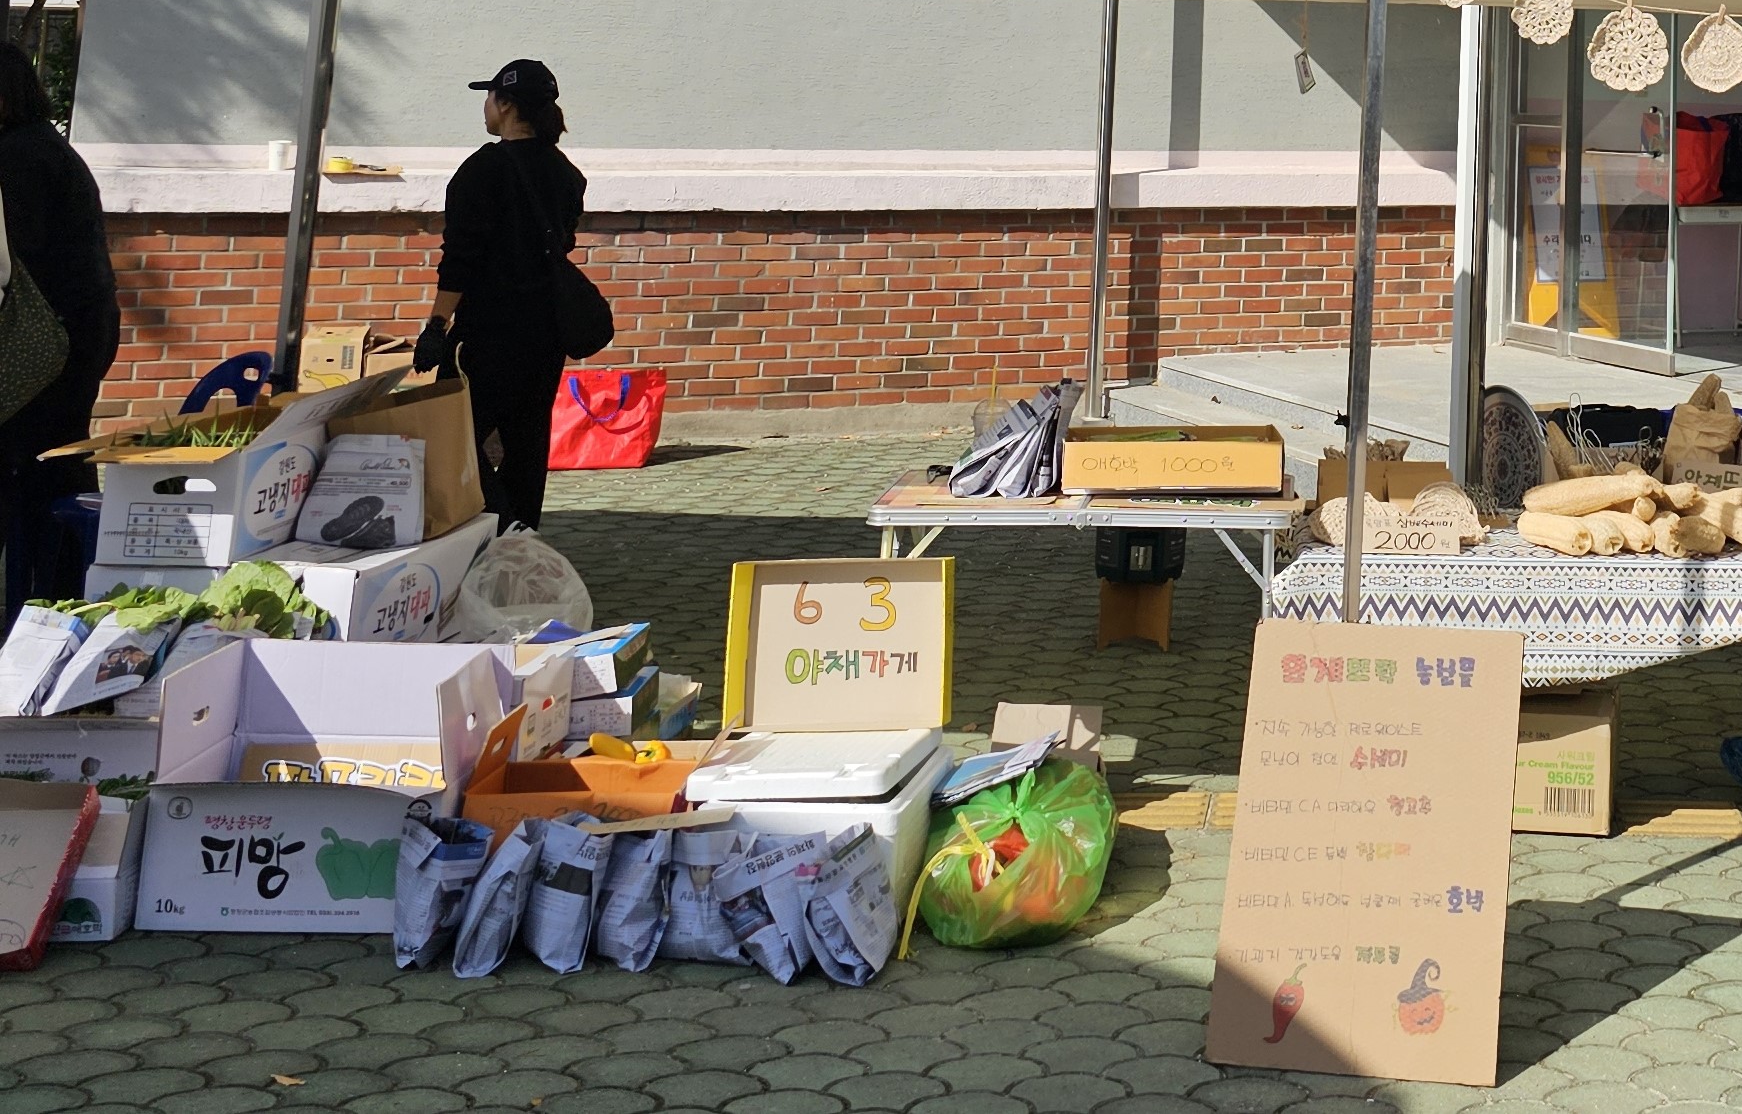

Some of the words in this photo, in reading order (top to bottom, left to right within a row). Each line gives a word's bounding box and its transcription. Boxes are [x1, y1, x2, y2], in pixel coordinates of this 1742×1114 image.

[1082, 454, 1139, 473] 애호박
[794, 581, 823, 624] 6
[859, 576, 897, 631] 3
[785, 649, 918, 685] 야채가게
[1528, 760, 1558, 768] Cream
[1561, 761, 1595, 770] Flavour
[1547, 771, 1595, 786] 956/52
[201, 836, 306, 899] 피망
[1446, 885, 1484, 913] 호박
